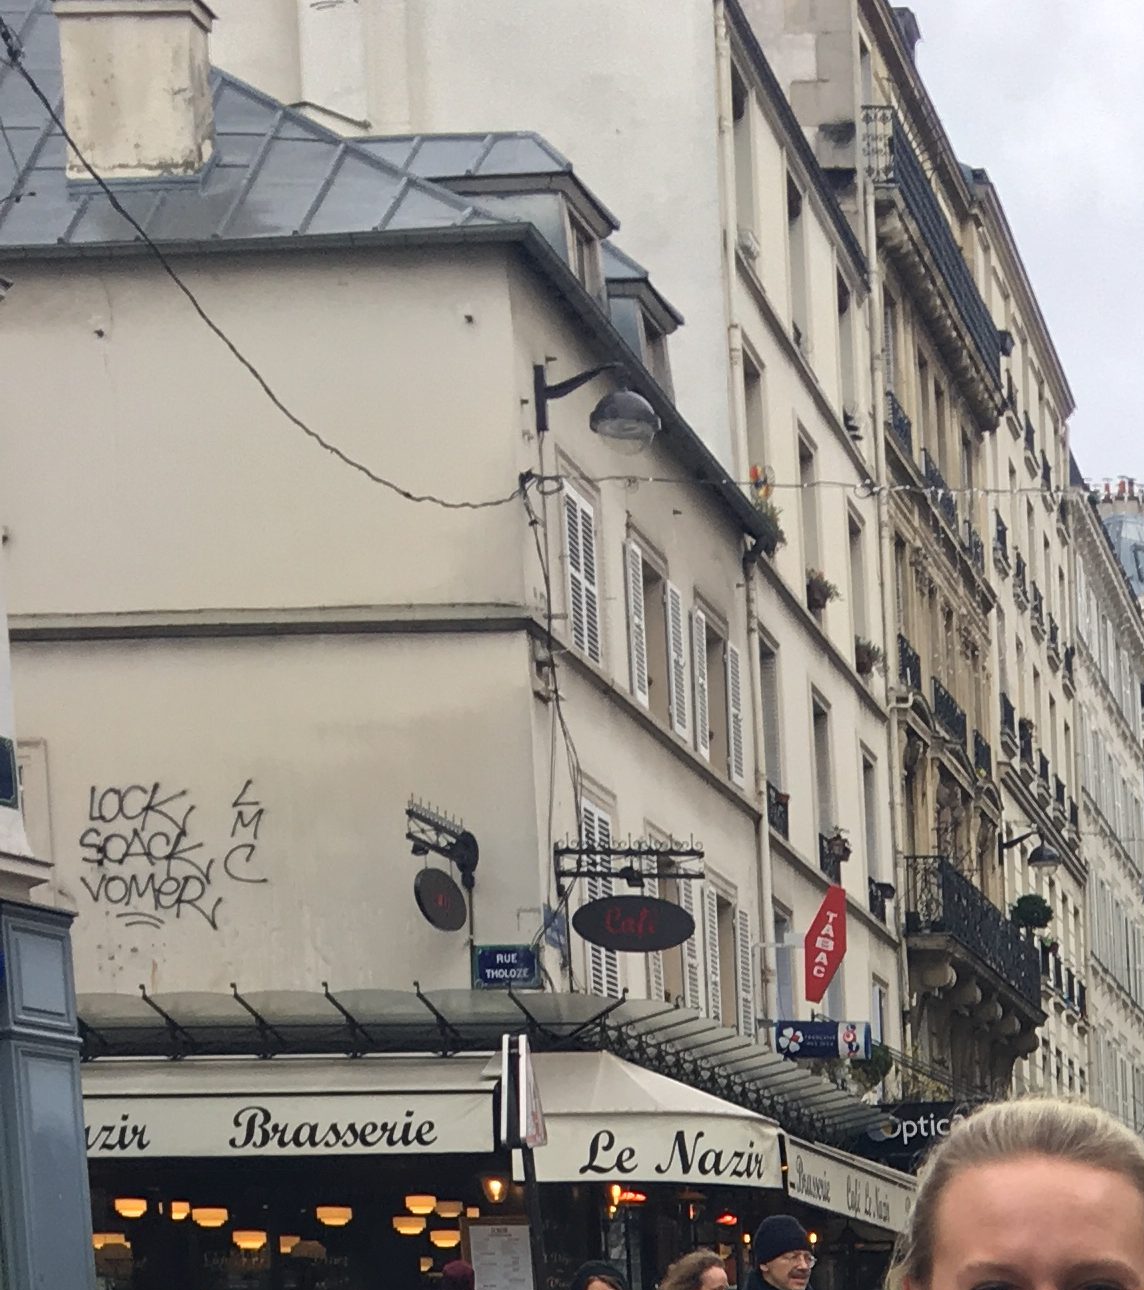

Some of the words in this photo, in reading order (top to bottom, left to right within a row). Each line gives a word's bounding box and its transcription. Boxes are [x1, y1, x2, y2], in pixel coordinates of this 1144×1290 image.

[496, 952, 518, 964] RUE
[812, 910, 838, 979] TABAC
[229, 1106, 438, 1149] Brasserie
[579, 1130, 638, 1175] Le
[654, 1130, 765, 1180] Nazir
